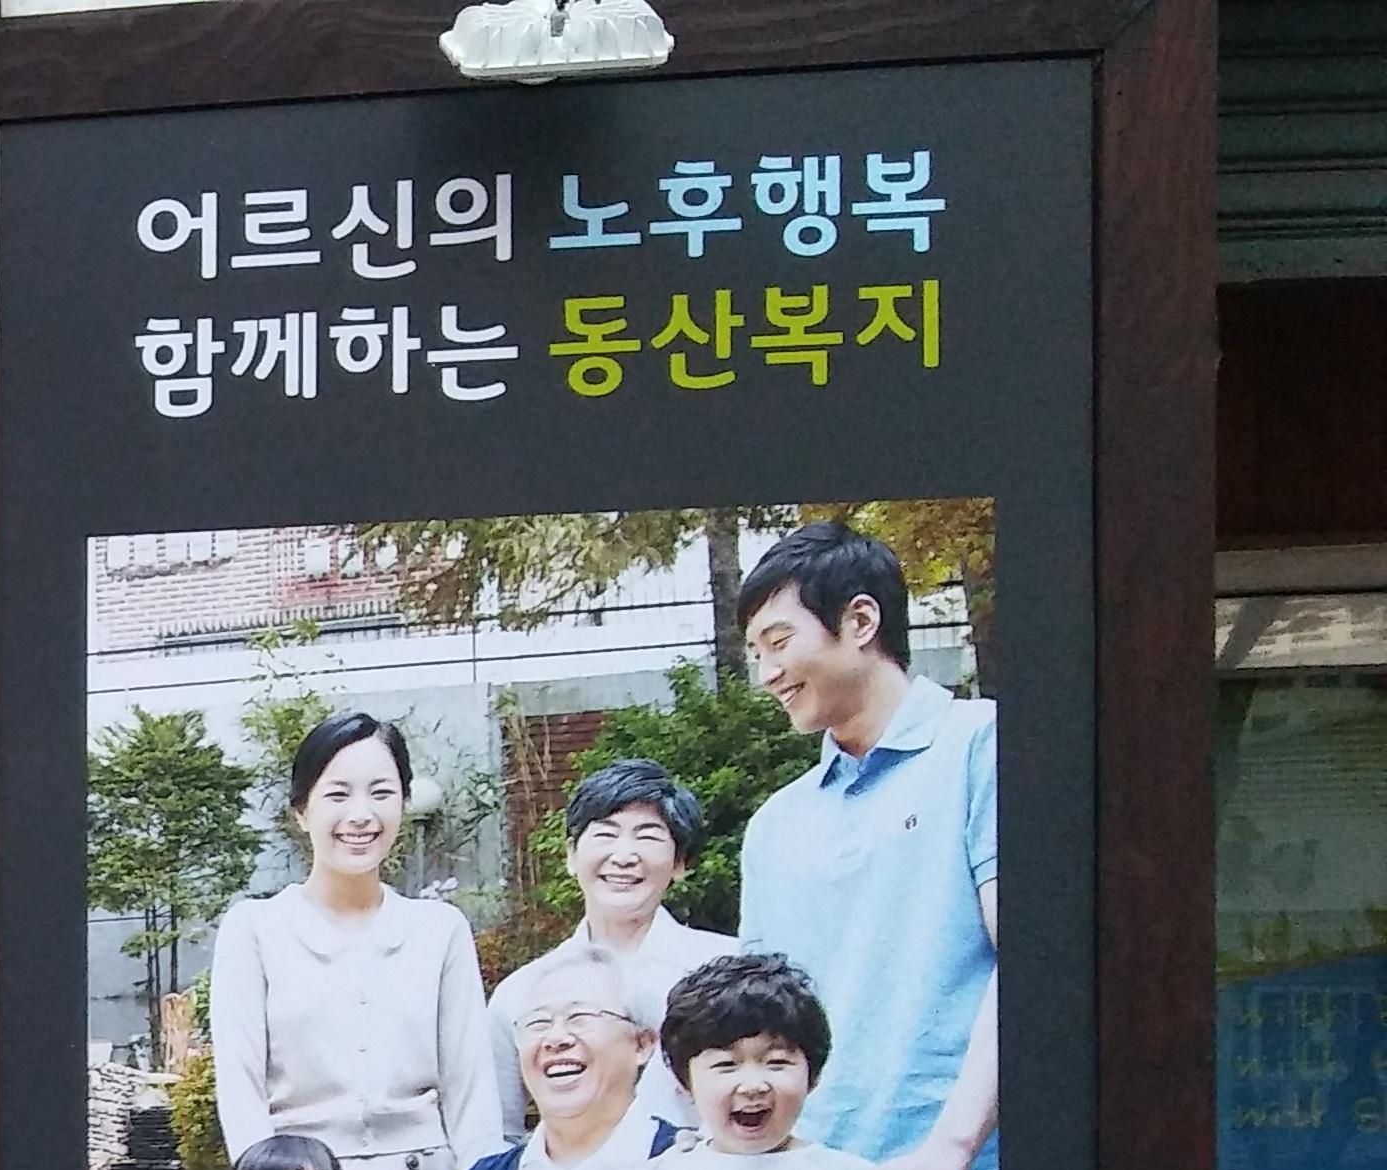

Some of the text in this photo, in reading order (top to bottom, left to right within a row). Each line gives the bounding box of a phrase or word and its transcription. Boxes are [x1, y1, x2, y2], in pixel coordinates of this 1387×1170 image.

[135, 149, 948, 280] 어르신의 노후행복
[134, 279, 943, 419] 함께하는 동산복지
